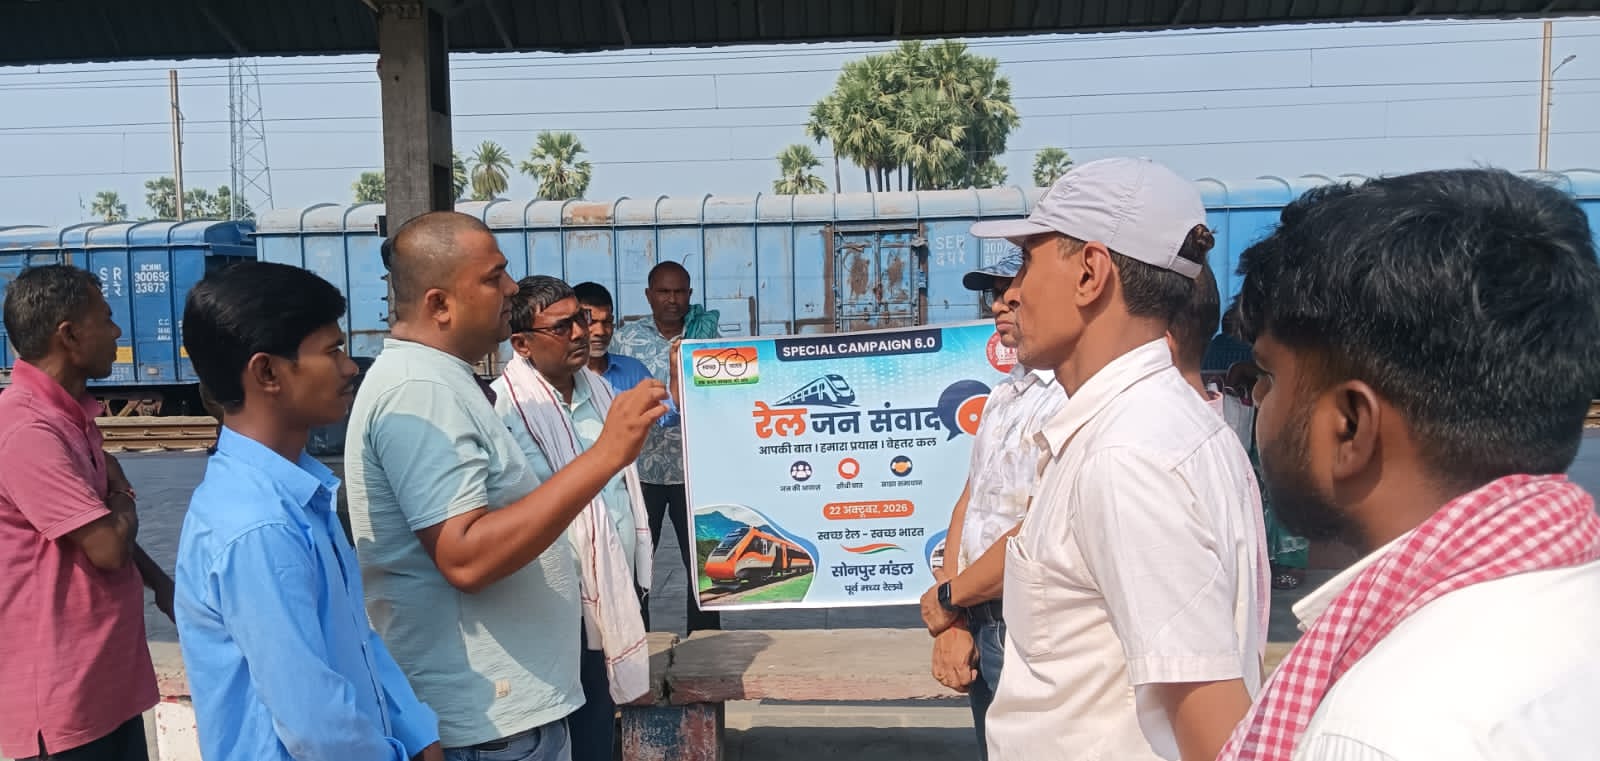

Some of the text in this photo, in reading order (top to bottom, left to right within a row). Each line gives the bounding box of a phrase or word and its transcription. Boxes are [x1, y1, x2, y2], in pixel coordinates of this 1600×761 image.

[783, 337, 936, 357] SPECIAL CAMPAIGN 6.0
[752, 400, 941, 439] रेल जन संवाद
[759, 441, 792, 455] आपकी
[819, 442, 848, 453] हमारा
[849, 440, 878, 452] प्रयास
[915, 437, 937, 448] कल
[829, 506, 841, 515] 22
[816, 530, 843, 541] स्वच्छ
[844, 528, 861, 540] रेल
[870, 528, 897, 539] स्वच्छ
[898, 527, 925, 537] भारत
[830, 560, 914, 581] सोनपुर मंडल
[844, 582, 858, 596] पूर्व
[882, 581, 904, 591] रेलवे
